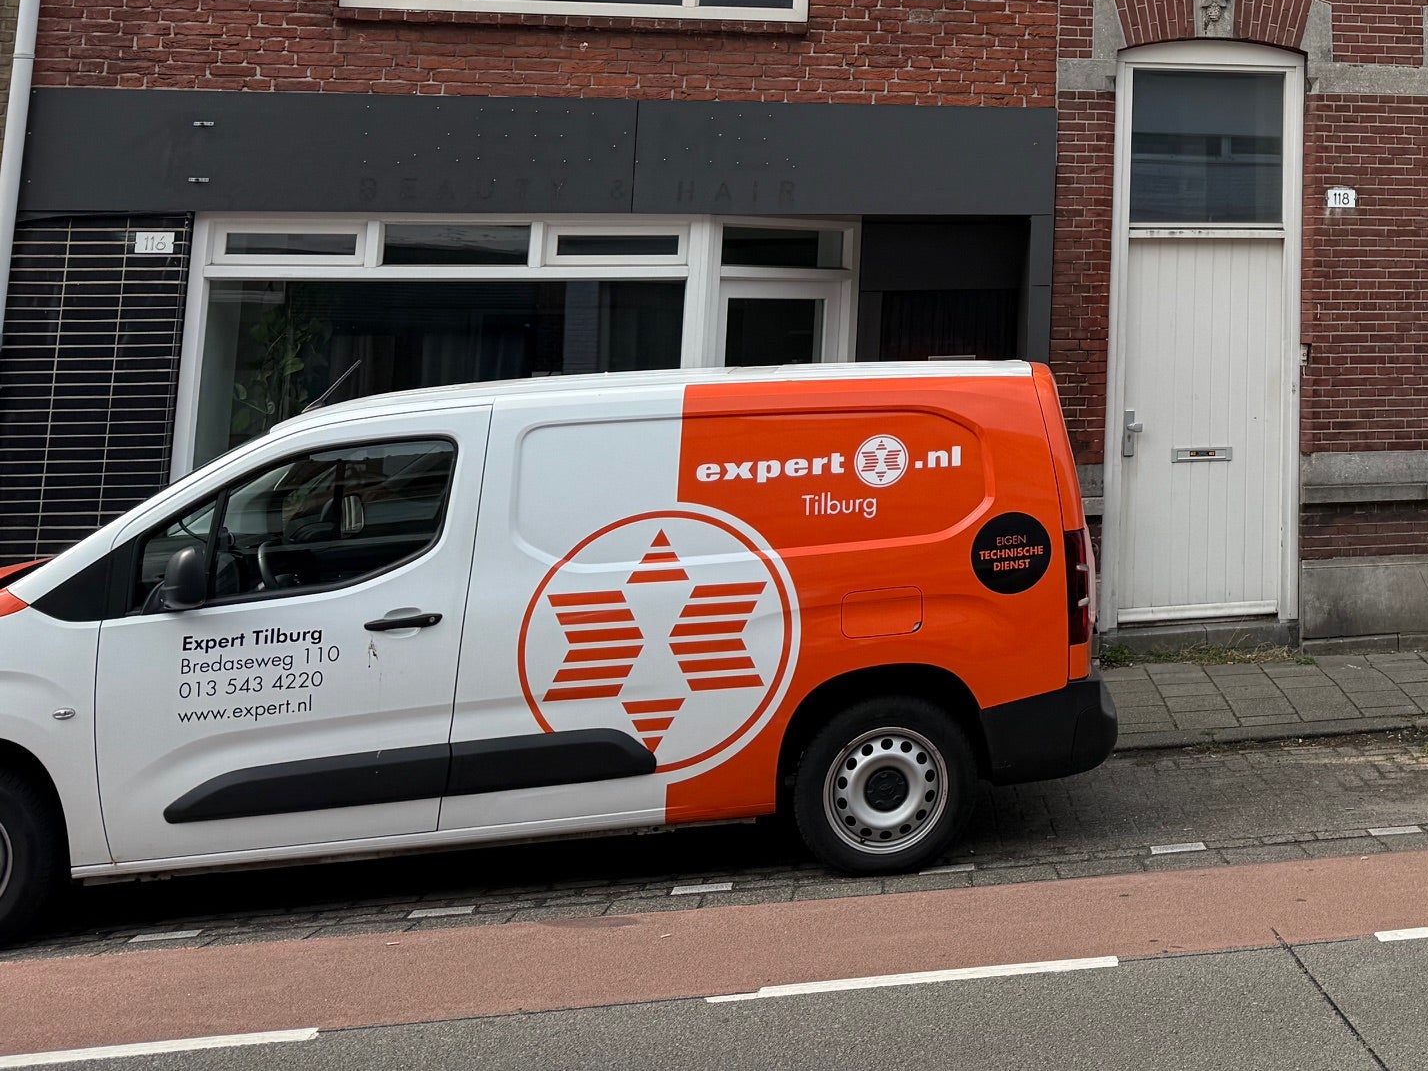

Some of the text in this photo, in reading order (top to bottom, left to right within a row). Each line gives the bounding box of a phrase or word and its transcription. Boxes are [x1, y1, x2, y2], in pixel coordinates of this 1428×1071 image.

[677, 180, 798, 203] HAIR
[1333, 192, 1350, 206] 118
[144, 235, 167, 251] 116
[696, 445, 962, 483] expert .nl
[801, 491, 877, 519] Tilburg
[996, 534, 1027, 546] EIGEN
[979, 545, 1044, 561] TECHNISCHE
[993, 559, 1031, 571] DIENST
[182, 627, 323, 654] Expert Tilburg
[180, 645, 340, 675] Bredaseweg 110
[179, 670, 324, 699] 013 543 4220
[177, 694, 313, 723] www.expert.nl
